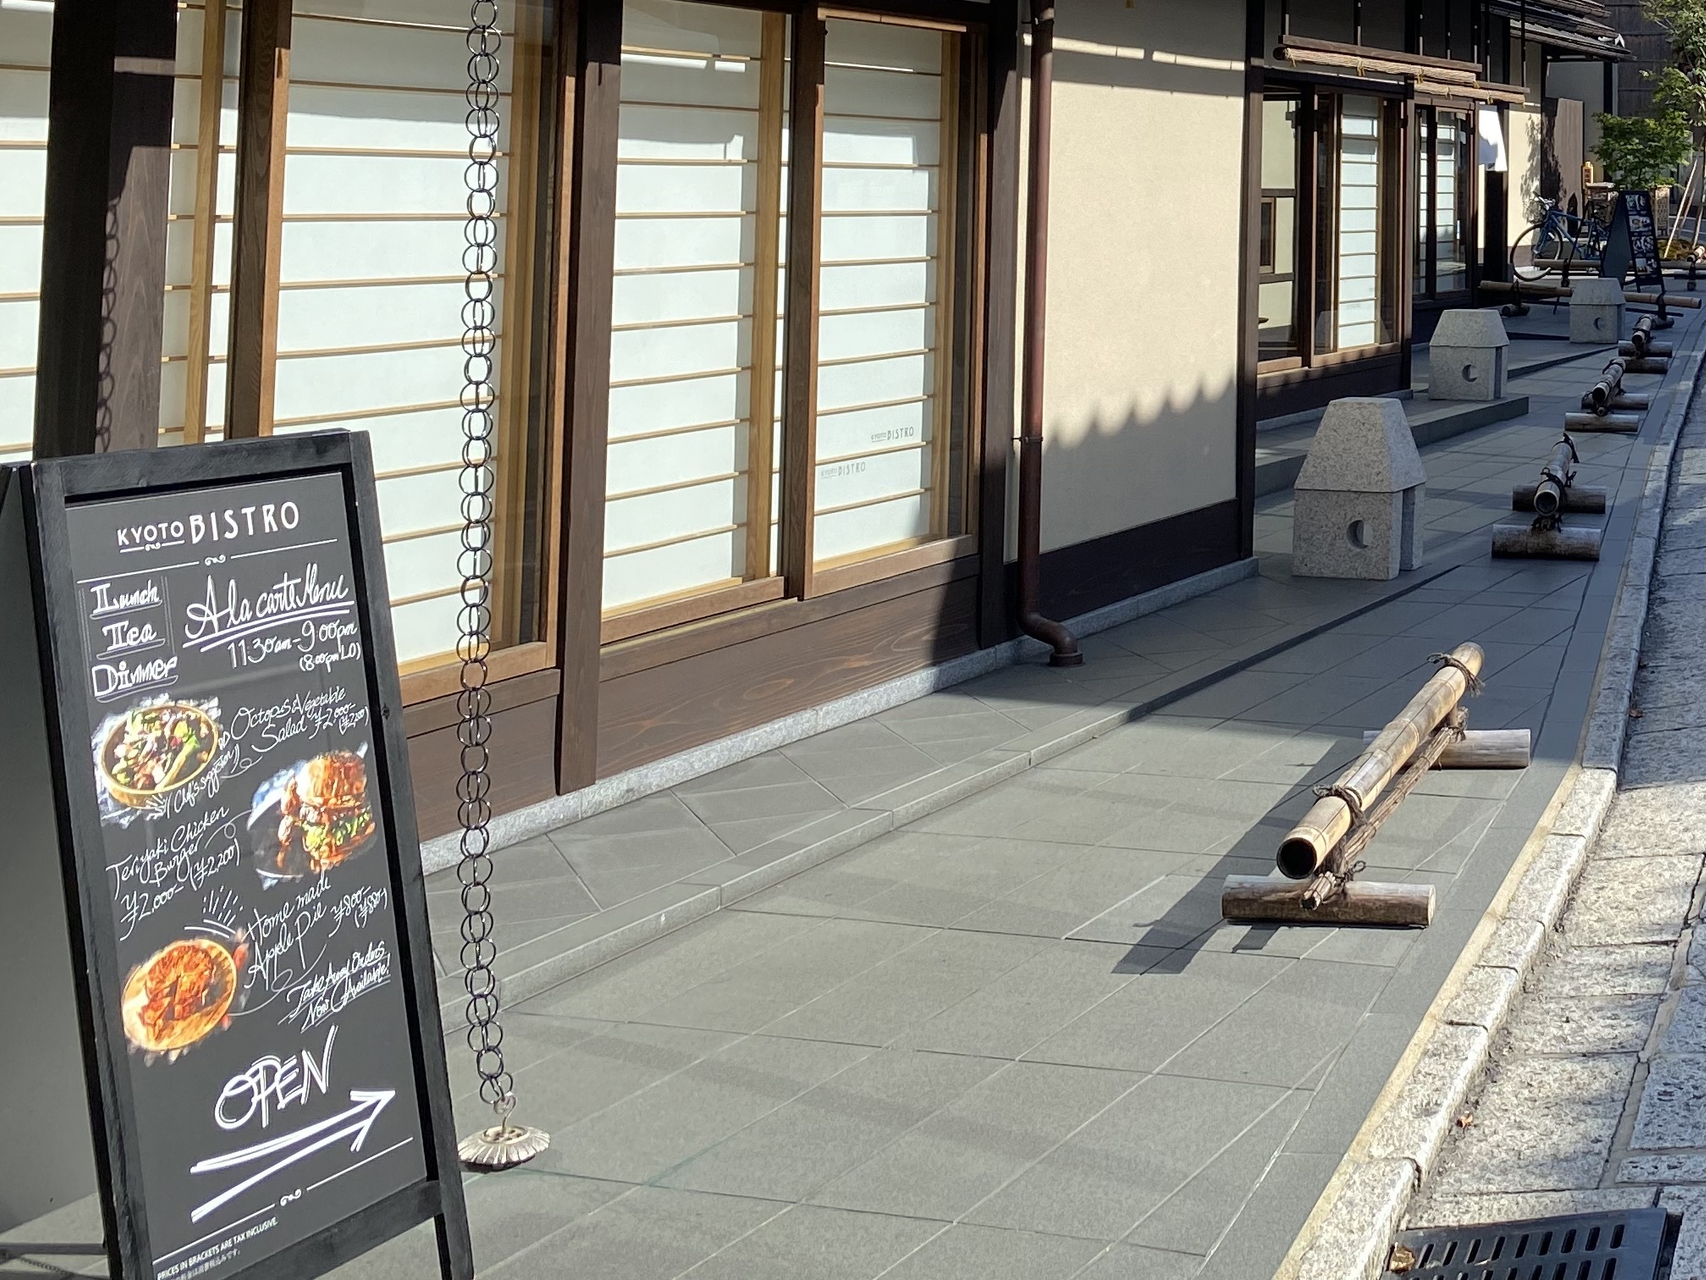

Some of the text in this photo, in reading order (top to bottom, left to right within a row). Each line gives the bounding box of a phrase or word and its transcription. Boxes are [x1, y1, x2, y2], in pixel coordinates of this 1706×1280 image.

[117, 501, 300, 547] KYOTO BISTRO
[90, 579, 160, 614] Lunch
[256, 572, 301, 618] carte
[296, 562, 349, 607] Menu
[102, 620, 157, 652] Tea
[91, 656, 178, 697] Dinner
[251, 715, 307, 753] Salad
[106, 806, 230, 900] Teriyaki Chicken
[148, 833, 204, 888] Burger
[240, 871, 332, 946] Home made
[244, 922, 294, 991] Apple
[294, 902, 328, 970] Pie
[214, 1024, 338, 1131] OPEN
[156, 1262, 180, 1280] PRICES
[188, 1244, 220, 1267] BRACKETS
[220, 1239, 233, 1252] ARE
[233, 1233, 246, 1245] TAX
[245, 1216, 279, 1240] INCLUSIVE
